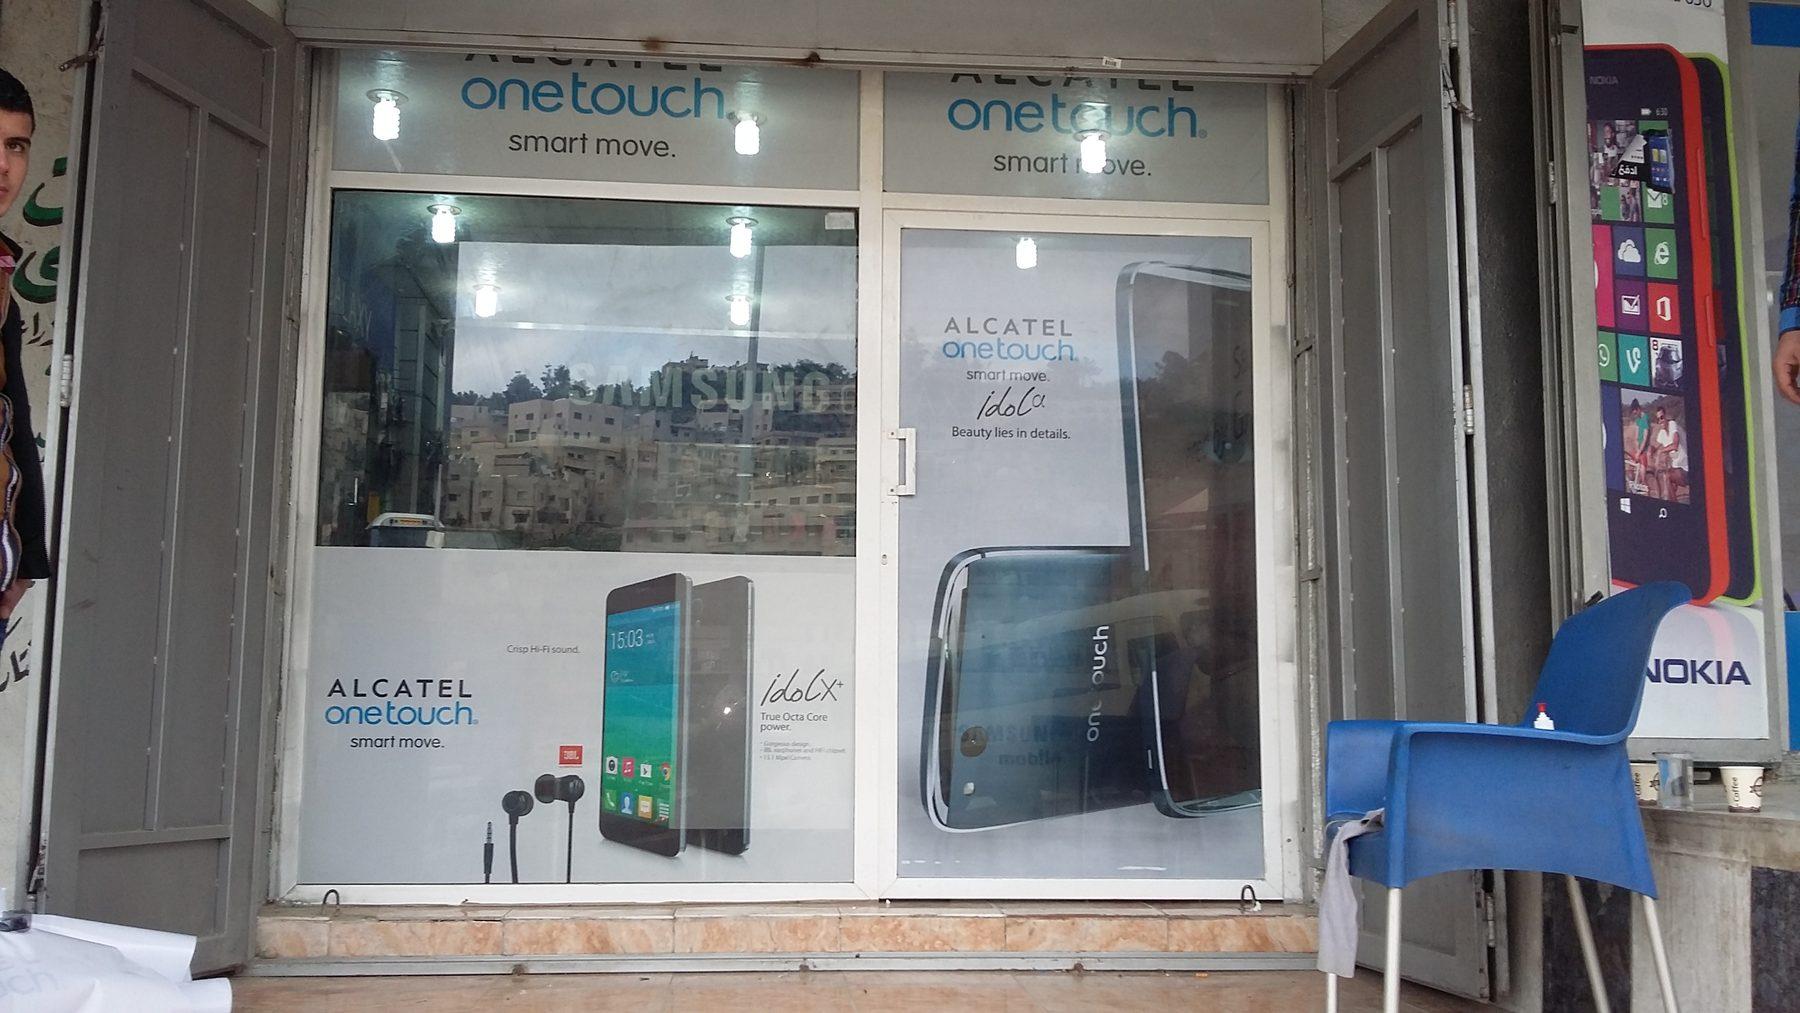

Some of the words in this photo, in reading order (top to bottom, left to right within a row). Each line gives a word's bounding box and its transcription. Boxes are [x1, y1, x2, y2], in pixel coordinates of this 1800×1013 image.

[508, 133, 588, 154] smart
[596, 136, 677, 158] move.
[993, 153, 1067, 174] smart
[944, 317, 1072, 337] ALCATEL
[966, 369, 1006, 381] smart
[1009, 370, 1050, 382] move.
[952, 426, 992, 440] Beauty
[994, 427, 1014, 439] lies
[1016, 428, 1028, 439] in
[1030, 428, 1071, 440] details.
[611, 628, 644, 650] 15:03
[327, 678, 473, 698] ALCATEL
[761, 712, 781, 721] True
[782, 712, 805, 721] Octa
[806, 712, 828, 721] Core
[350, 735, 395, 749] smart
[398, 736, 445, 749] move.
